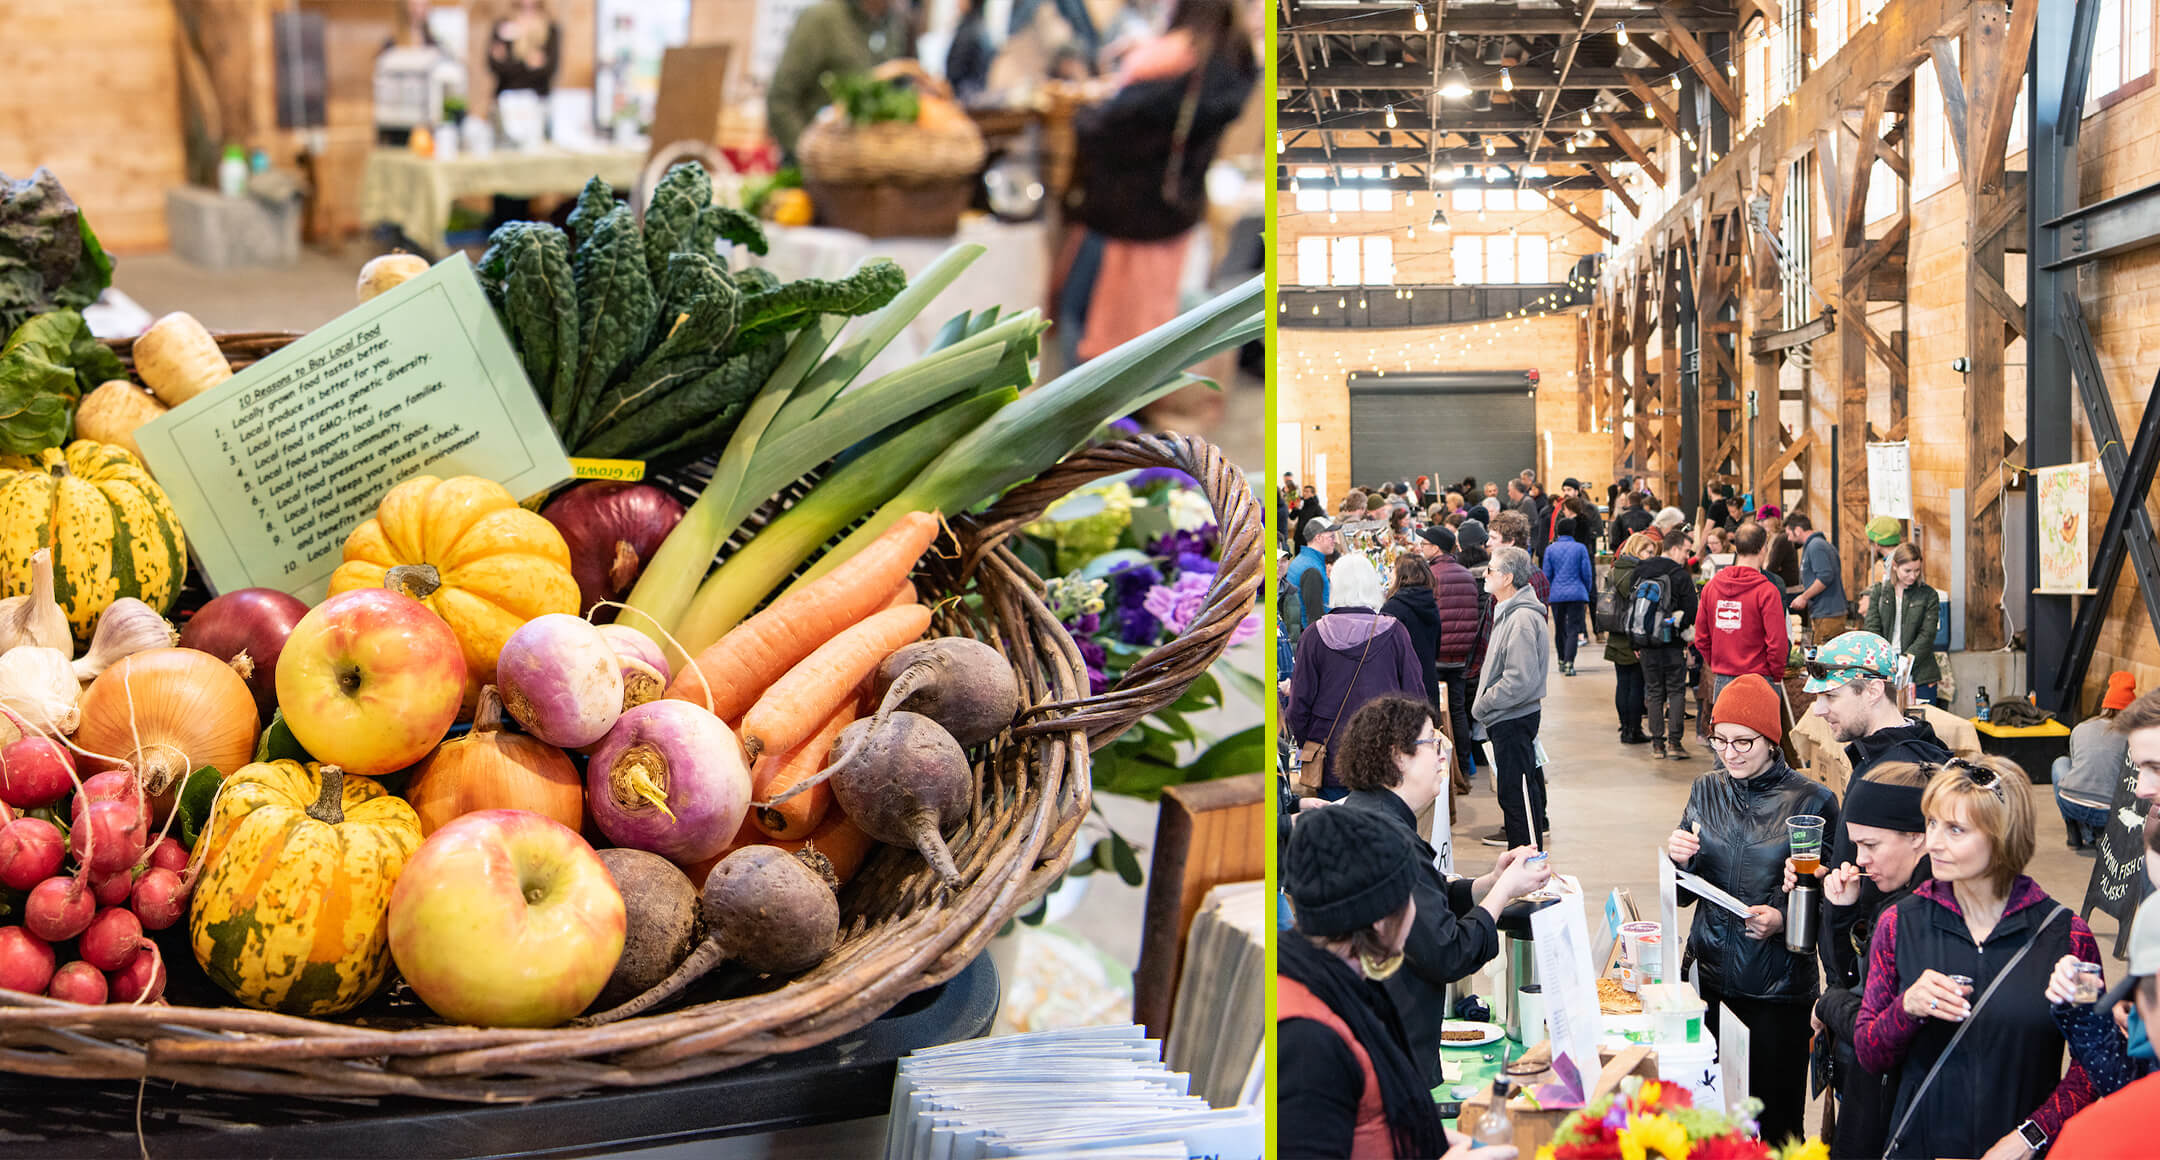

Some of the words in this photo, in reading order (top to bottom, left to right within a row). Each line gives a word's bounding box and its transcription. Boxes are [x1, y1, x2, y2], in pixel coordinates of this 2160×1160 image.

[230, 455, 241, 466] 3.
[247, 435, 271, 457] Local
[275, 421, 296, 441] food
[300, 398, 346, 431] preserves
[349, 378, 382, 405] genetic
[387, 353, 432, 382] diversity.
[232, 406, 265, 430] Locally
[268, 390, 296, 413] grown
[299, 374, 320, 393] food
[324, 358, 354, 379] tastes
[357, 339, 392, 362] better.
[239, 394, 252, 410] 10
[254, 373, 291, 401] Reasons
[295, 367, 305, 378] to
[309, 355, 326, 371] Buy
[329, 337, 354, 360] Local
[357, 323, 381, 344] Food
[240, 422, 264, 443] Local
[268, 403, 304, 431] produce
[308, 396, 316, 406] is
[319, 378, 350, 400] better
[354, 366, 369, 381] for
[373, 357, 392, 374] you.
[255, 448, 279, 470] Local
[282, 435, 304, 455] food
[307, 431, 315, 441] is
[318, 404, 372, 435] GMO-free.
[258, 463, 282, 486] Local
[286, 451, 307, 470] food
[311, 431, 350, 458] supports
[353, 414, 375, 435] local
[379, 403, 402, 421] farm
[405, 381, 446, 406] families.
[269, 476, 294, 497] Local
[298, 462, 319, 481] food
[321, 448, 349, 469] builds
[352, 422, 405, 453] community.
[277, 489, 301, 511] Local
[305, 475, 326, 495] food
[329, 453, 374, 486] preserves
[378, 440, 401, 457] open
[403, 424, 433, 444] space.
[284, 502, 308, 524] Local
[312, 489, 333, 509] food
[336, 476, 362, 496] keeps
[366, 464, 387, 482] your
[391, 447, 417, 466] taxes
[421, 441, 430, 452] in
[432, 423, 464, 445] check.
[576, 466, 624, 480] Grown
[291, 516, 316, 537] Local
[319, 503, 340, 523] food
[344, 483, 383, 510] supports
[386, 478, 394, 487] a
[396, 464, 421, 482] clean
[424, 431, 481, 467] environment
[284, 560, 299, 575] 10.
[307, 541, 332, 563] Local
[297, 533, 315, 551] and
[317, 514, 356, 541] benefits
[2118, 858, 2137, 881] FISH
